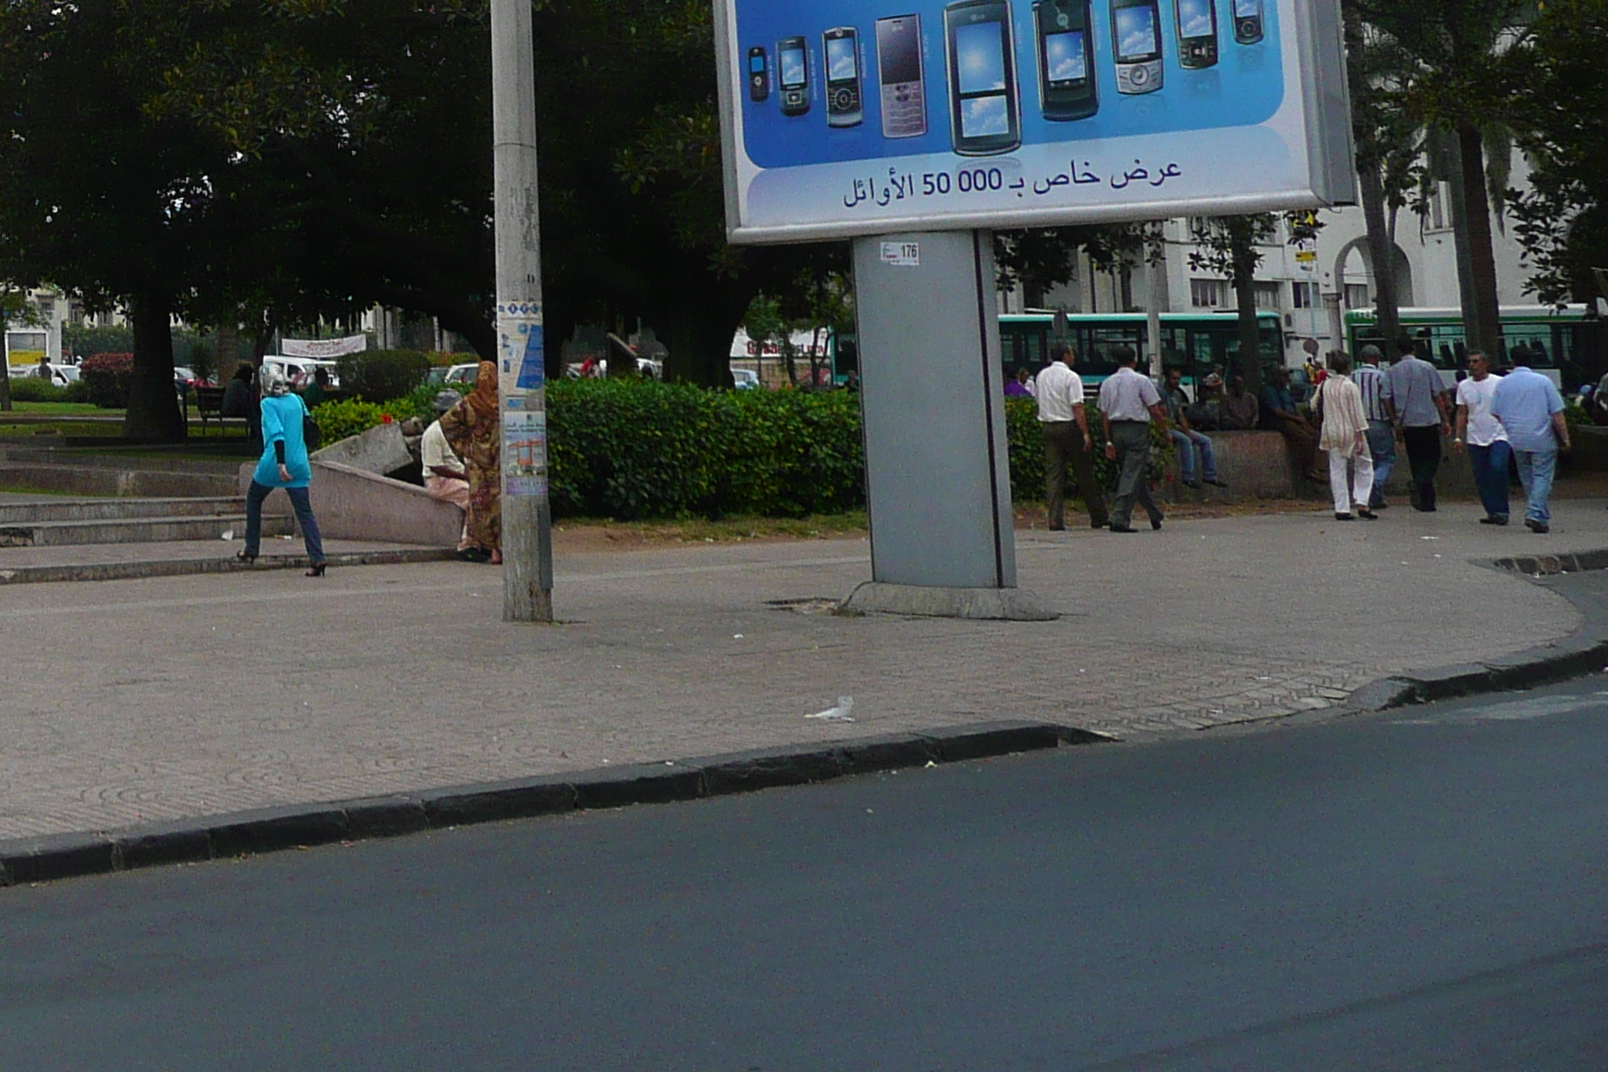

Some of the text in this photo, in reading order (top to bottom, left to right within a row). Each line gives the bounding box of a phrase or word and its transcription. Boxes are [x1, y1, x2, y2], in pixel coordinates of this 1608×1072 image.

[923, 173, 951, 196] 50
[957, 167, 1002, 193] 000
[1033, 159, 1101, 194] خاص
[1110, 158, 1182, 188] عرض
[843, 167, 914, 208] الأوائل
[902, 244, 917, 258] 176
